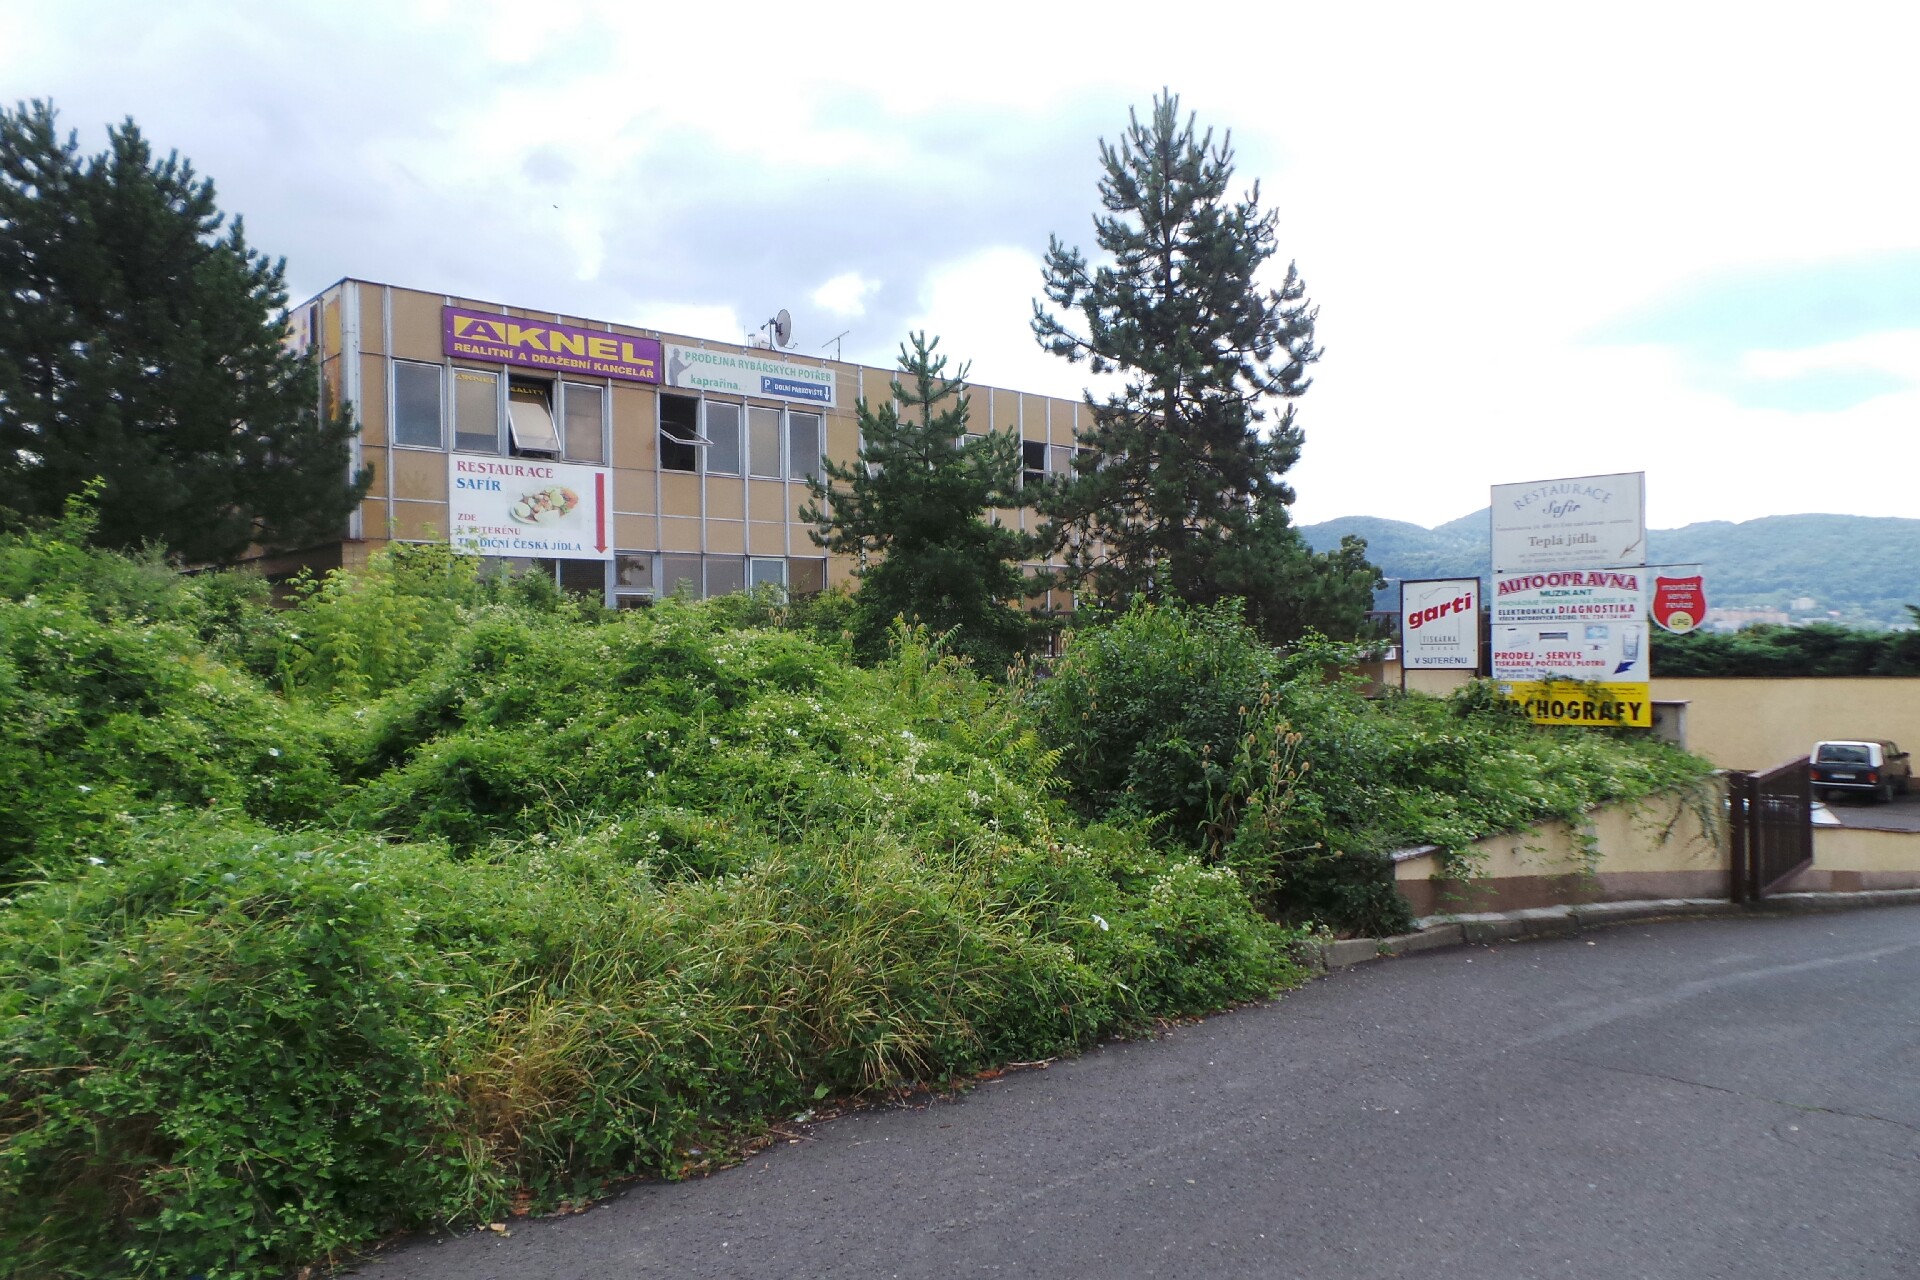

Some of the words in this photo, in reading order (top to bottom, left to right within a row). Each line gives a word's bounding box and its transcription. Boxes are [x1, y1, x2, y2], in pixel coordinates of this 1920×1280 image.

[454, 315, 654, 366] AKNEL
[454, 342, 513, 359] REALITNÍ
[518, 352, 527, 361] A
[532, 353, 591, 370] DRAŽEBNÍ
[594, 362, 654, 379] KANCELÁŘ
[685, 351, 736, 368] PRODEJNA
[738, 356, 796, 377] RYBÁŘSKÝCH
[798, 367, 832, 382] POTŘEB
[509, 386, 544, 395] EALITY
[764, 379, 771, 389] P
[774, 383, 791, 392] DOLNÍ
[456, 460, 554, 479] RESTAURACE
[456, 476, 502, 492] SAFÍR
[1513, 483, 1613, 511] RESTAURACE
[457, 513, 477, 522] ZDE
[468, 525, 521, 536] TERÉNU
[458, 537, 510, 549] TDIČNÍ
[513, 537, 549, 550] ČESKÁ
[551, 541, 582, 551] JÍDLA
[1528, 534, 1563, 549] Teplá
[1568, 532, 1598, 546] jídla
[1497, 571, 1640, 597] AUTOOPRAVNA
[1539, 589, 1594, 597] MUZIKANT
[1408, 592, 1472, 630] garti
[1558, 604, 1636, 614] DIAGNOSTIKA
[1422, 655, 1467, 664] SUTERÉNU
[1494, 652, 1534, 660] PRODEJ
[1546, 651, 1582, 660] SERVIS
[1497, 699, 1643, 721] ACHOGRAFY
